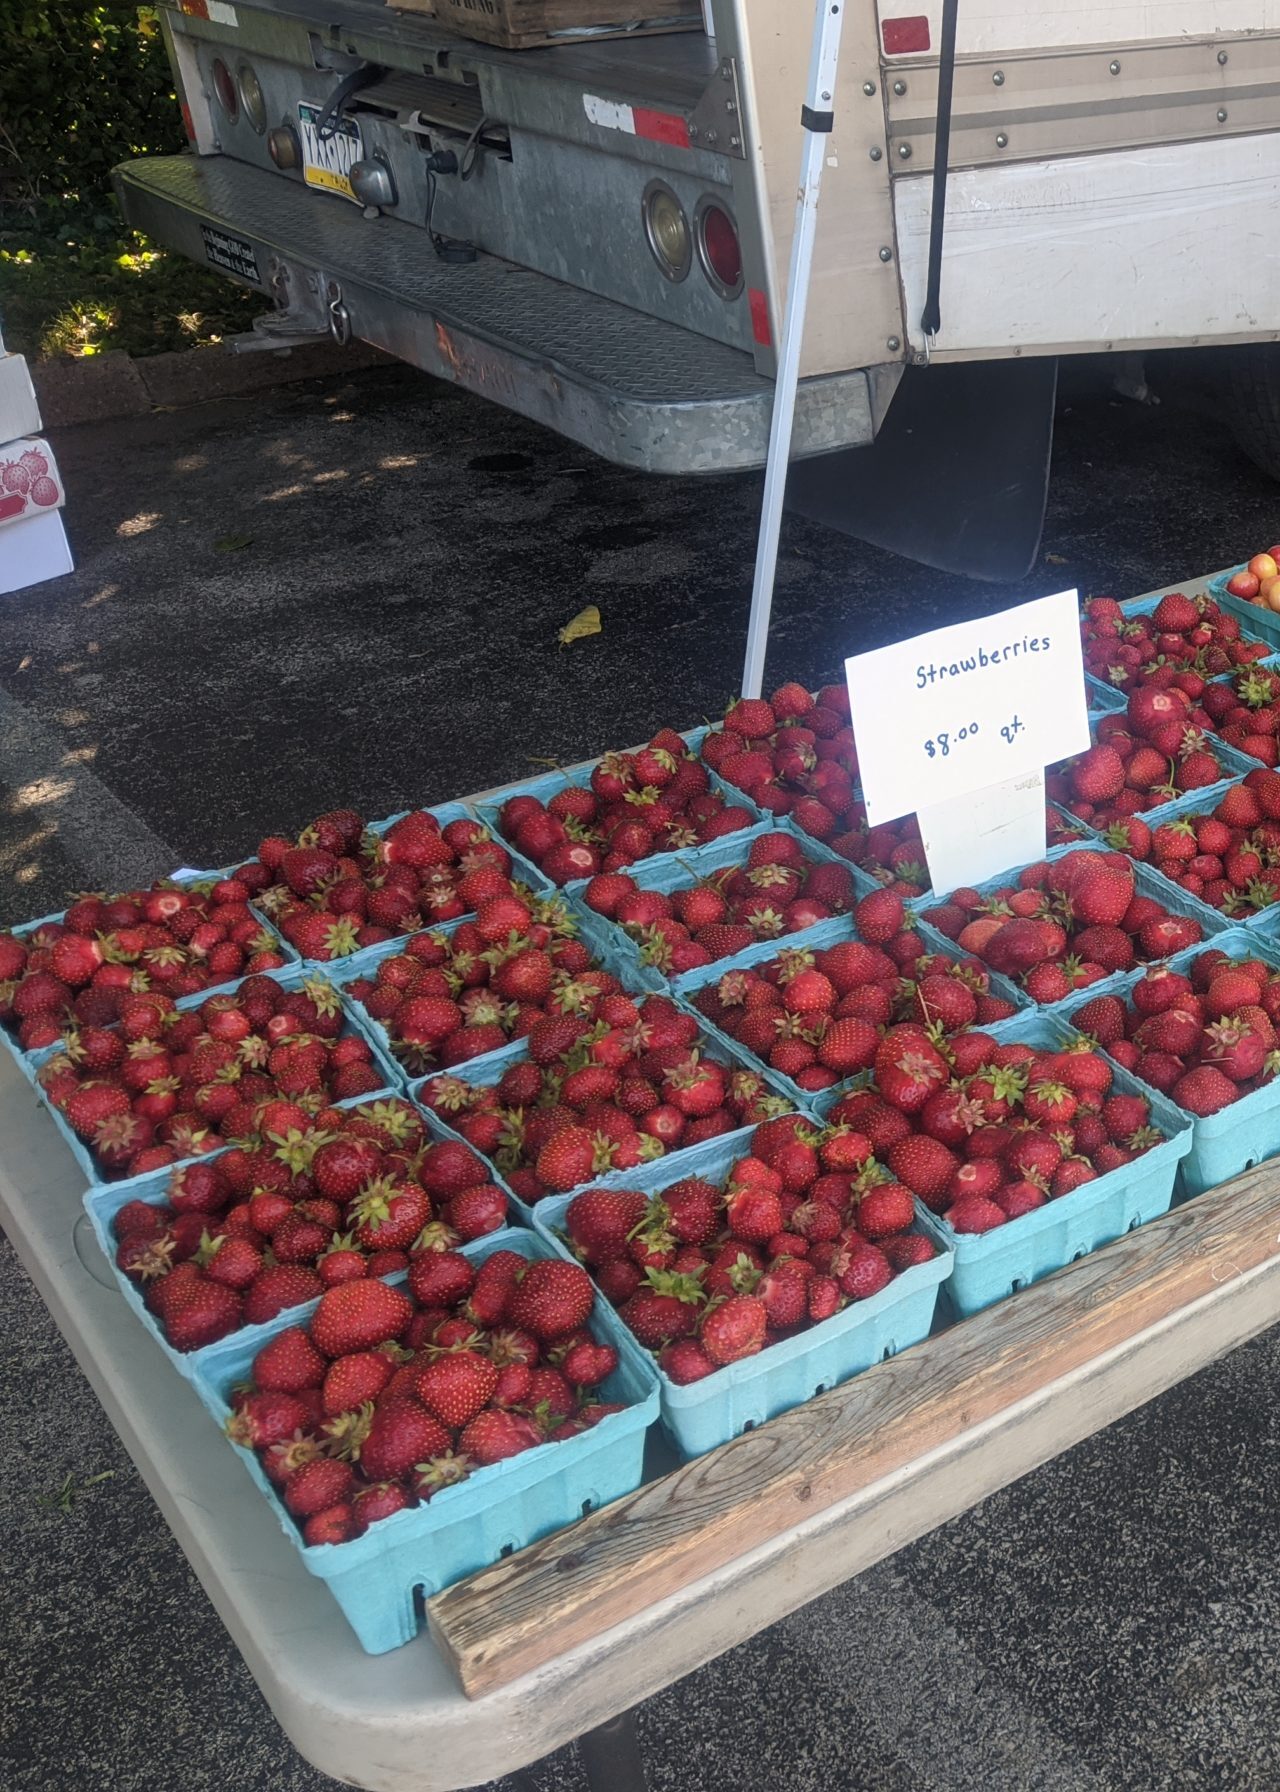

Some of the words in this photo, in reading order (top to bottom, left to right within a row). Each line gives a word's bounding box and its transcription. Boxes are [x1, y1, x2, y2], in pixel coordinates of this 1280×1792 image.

[916, 635, 1051, 689] Strawberries
[923, 721, 979, 759] $8.00
[1000, 715, 1026, 744] qt.
